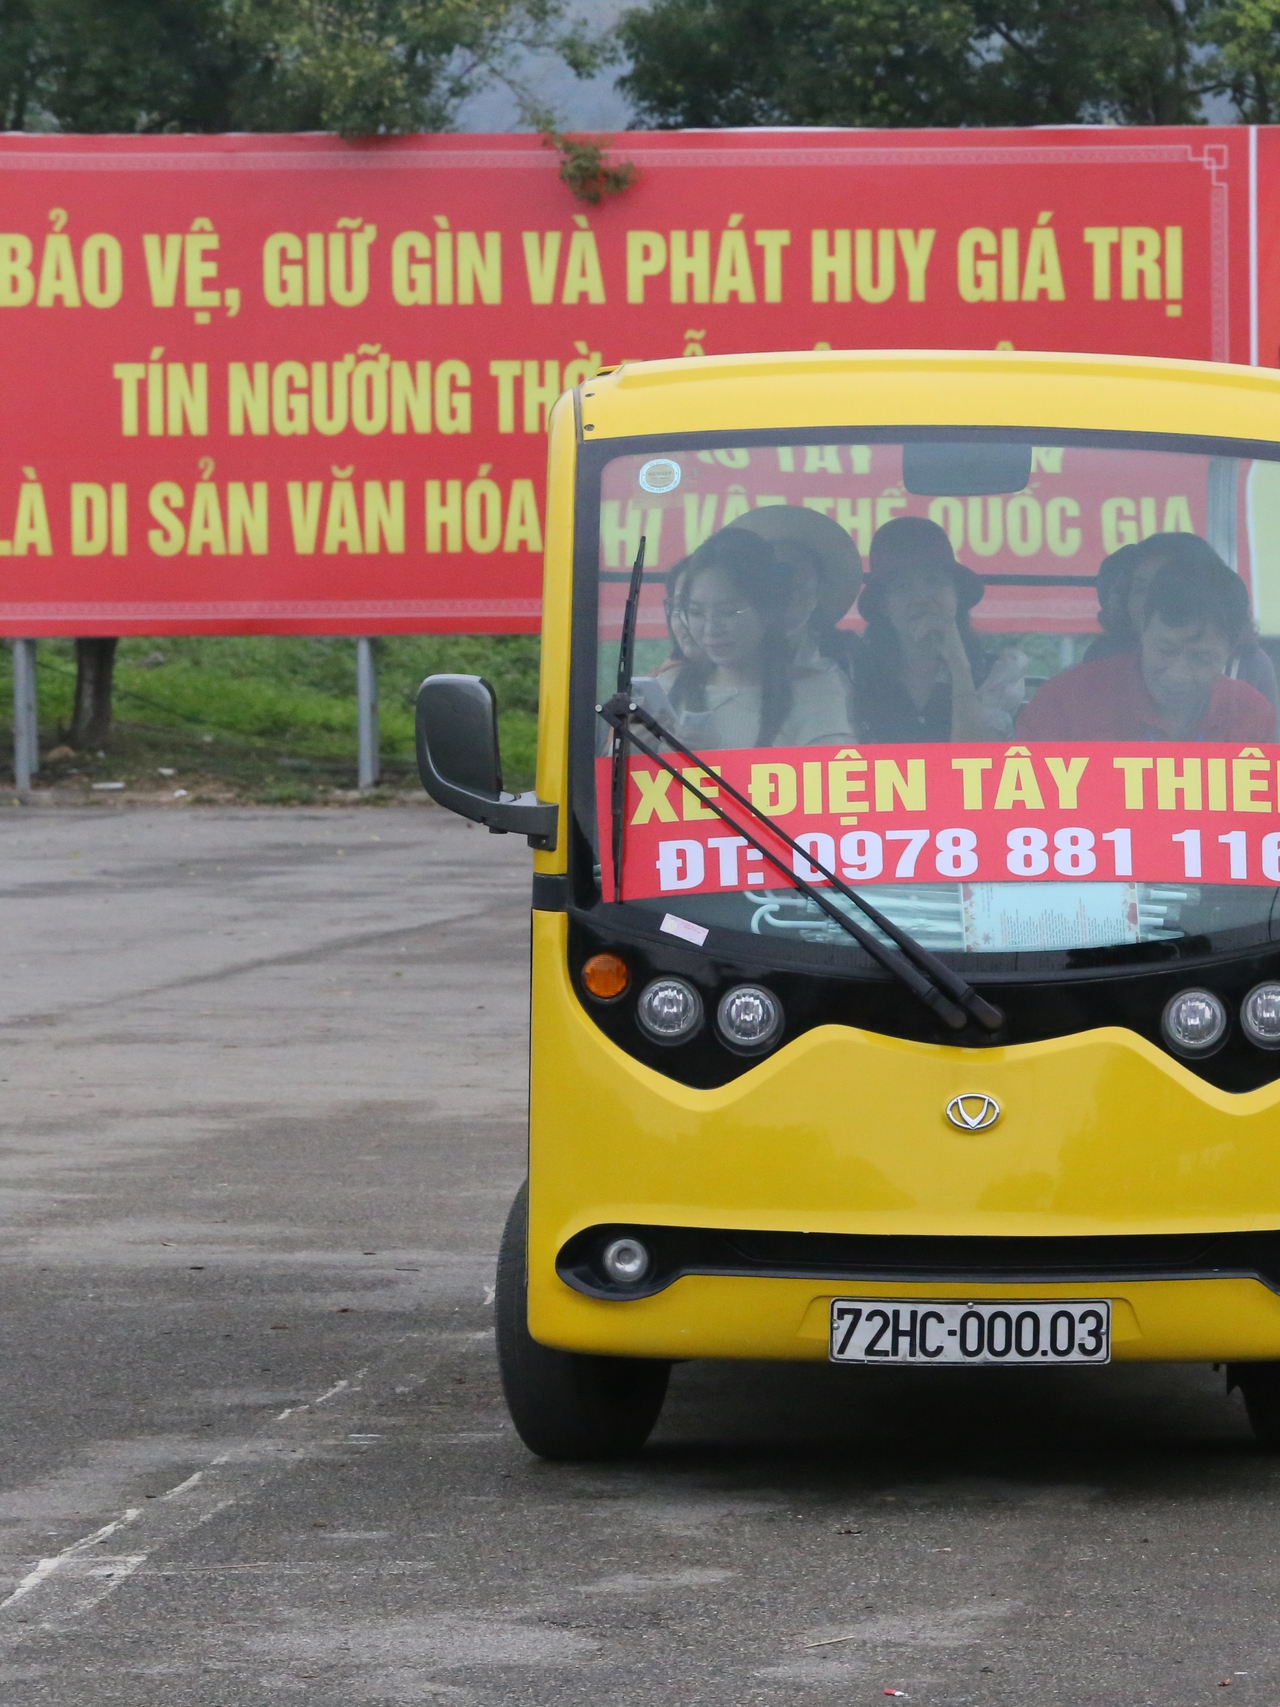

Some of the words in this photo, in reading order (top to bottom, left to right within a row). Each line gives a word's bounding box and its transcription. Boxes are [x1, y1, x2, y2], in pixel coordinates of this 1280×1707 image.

[0, 207, 123, 308] BẢO
[143, 216, 241, 325] VỆ,
[262, 215, 378, 307] GIỮ
[391, 214, 502, 306] GÌN
[522, 214, 606, 305] VÀ
[625, 213, 791, 304] PHÁT
[811, 228, 936, 304] HUY
[957, 211, 1066, 303] GIÁ
[1084, 225, 1184, 318] TRỊ
[113, 346, 209, 437] TÍN
[228, 342, 472, 436] NGƯỠNG
[0, 466, 53, 557] À
[70, 481, 128, 557] DI
[147, 456, 269, 557] SẢN
[287, 464, 405, 555] VĂN
[425, 462, 544, 554] HÓA
[630, 765, 722, 826] XE
[748, 748, 927, 826] ĐIỆN
[951, 745, 1090, 811] TÂY
[655, 836, 764, 891] ĐT:
[792, 827, 979, 882] 0978
[1005, 826, 1133, 877] 881
[835, 1307, 1104, 1358] 72HC-000.03
